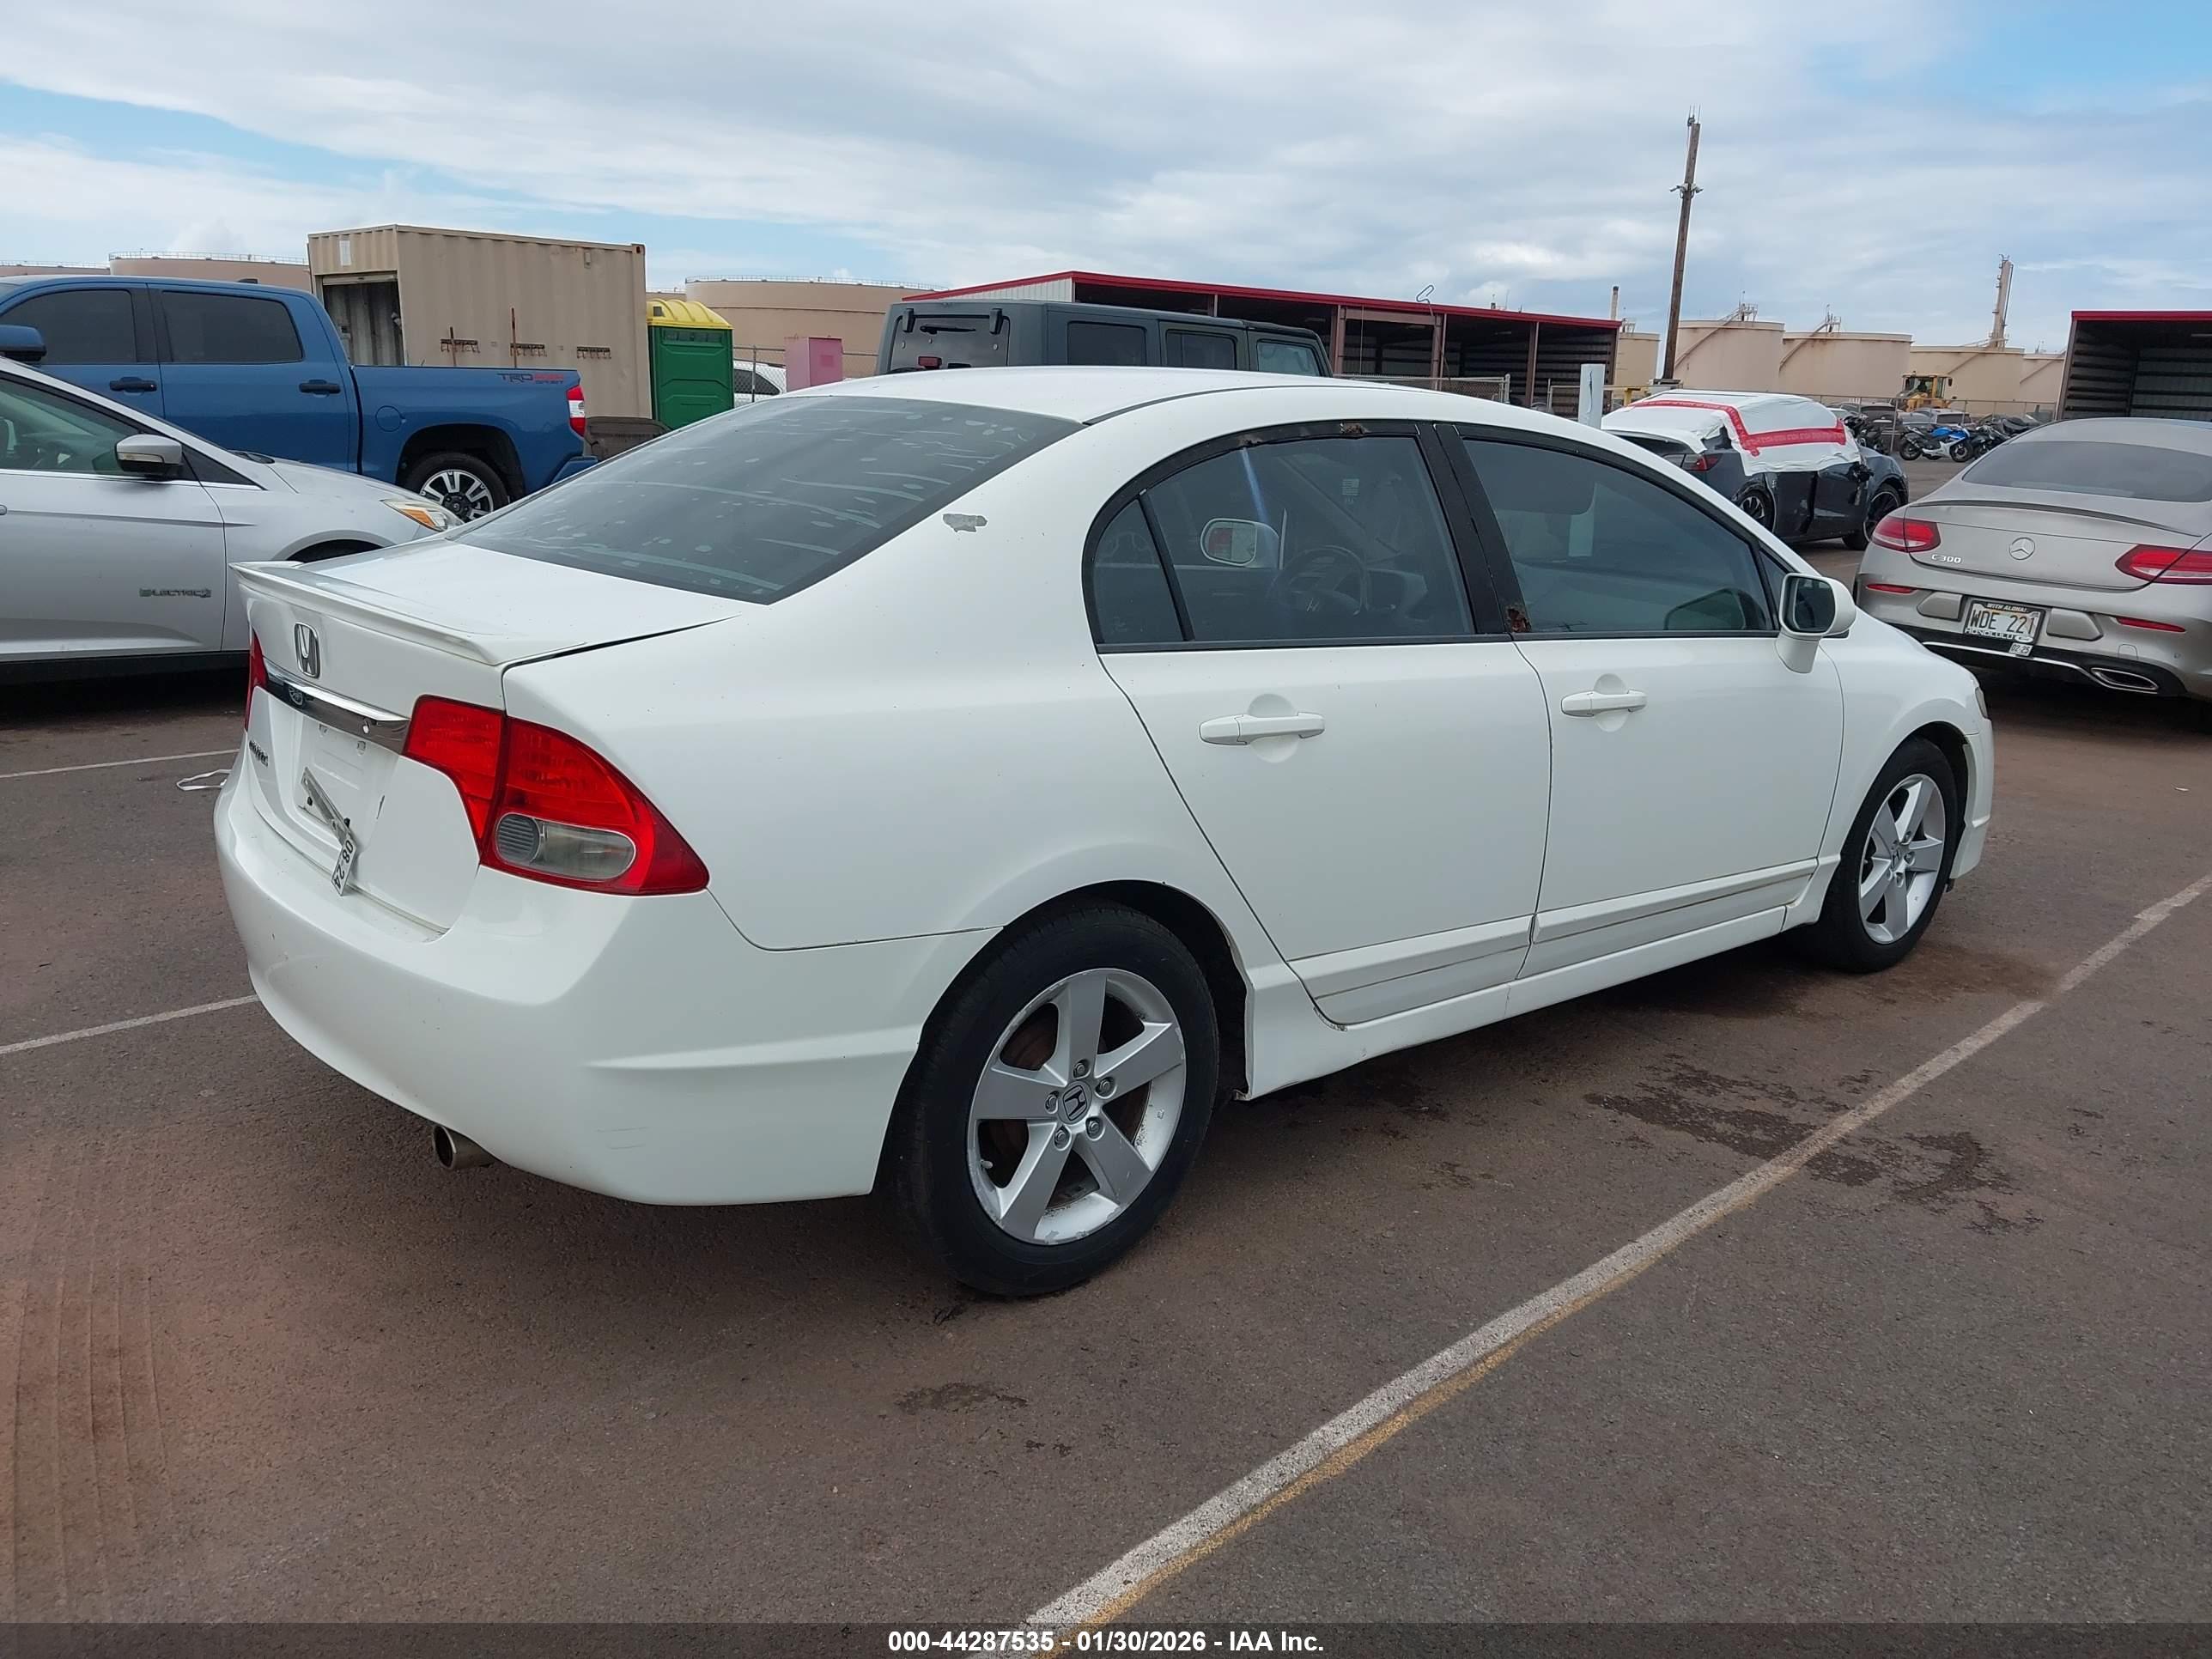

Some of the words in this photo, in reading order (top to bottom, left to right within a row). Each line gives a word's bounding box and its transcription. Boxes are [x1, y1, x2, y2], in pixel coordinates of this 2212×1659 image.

[496, 373, 533, 383] TRD
[1940, 555, 1962, 563] 300
[1971, 610, 2000, 630] WDE
[2006, 615, 2035, 635] 221
